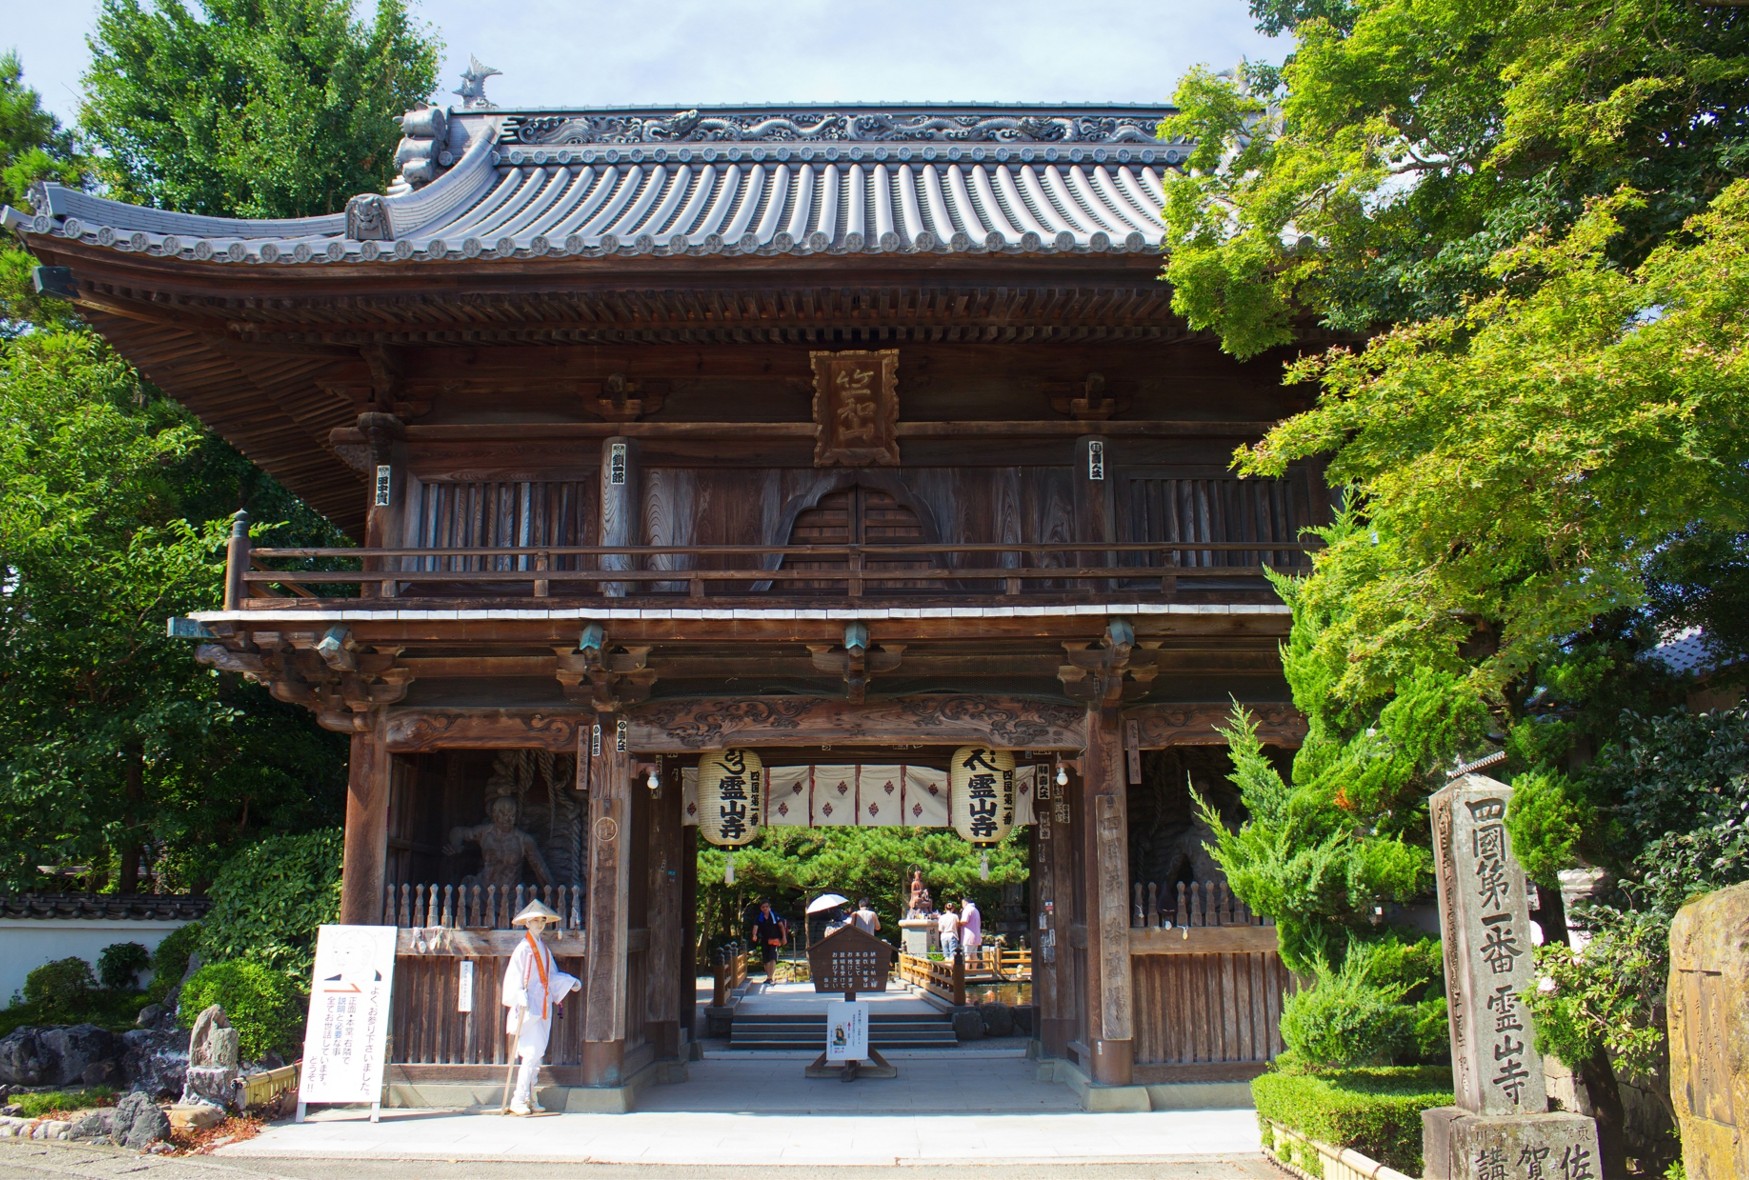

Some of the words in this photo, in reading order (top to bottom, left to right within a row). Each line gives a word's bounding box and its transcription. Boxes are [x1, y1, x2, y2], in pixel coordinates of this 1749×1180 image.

[718, 775, 748, 840] 霊山寺
[968, 773, 999, 838] 霊山寺
